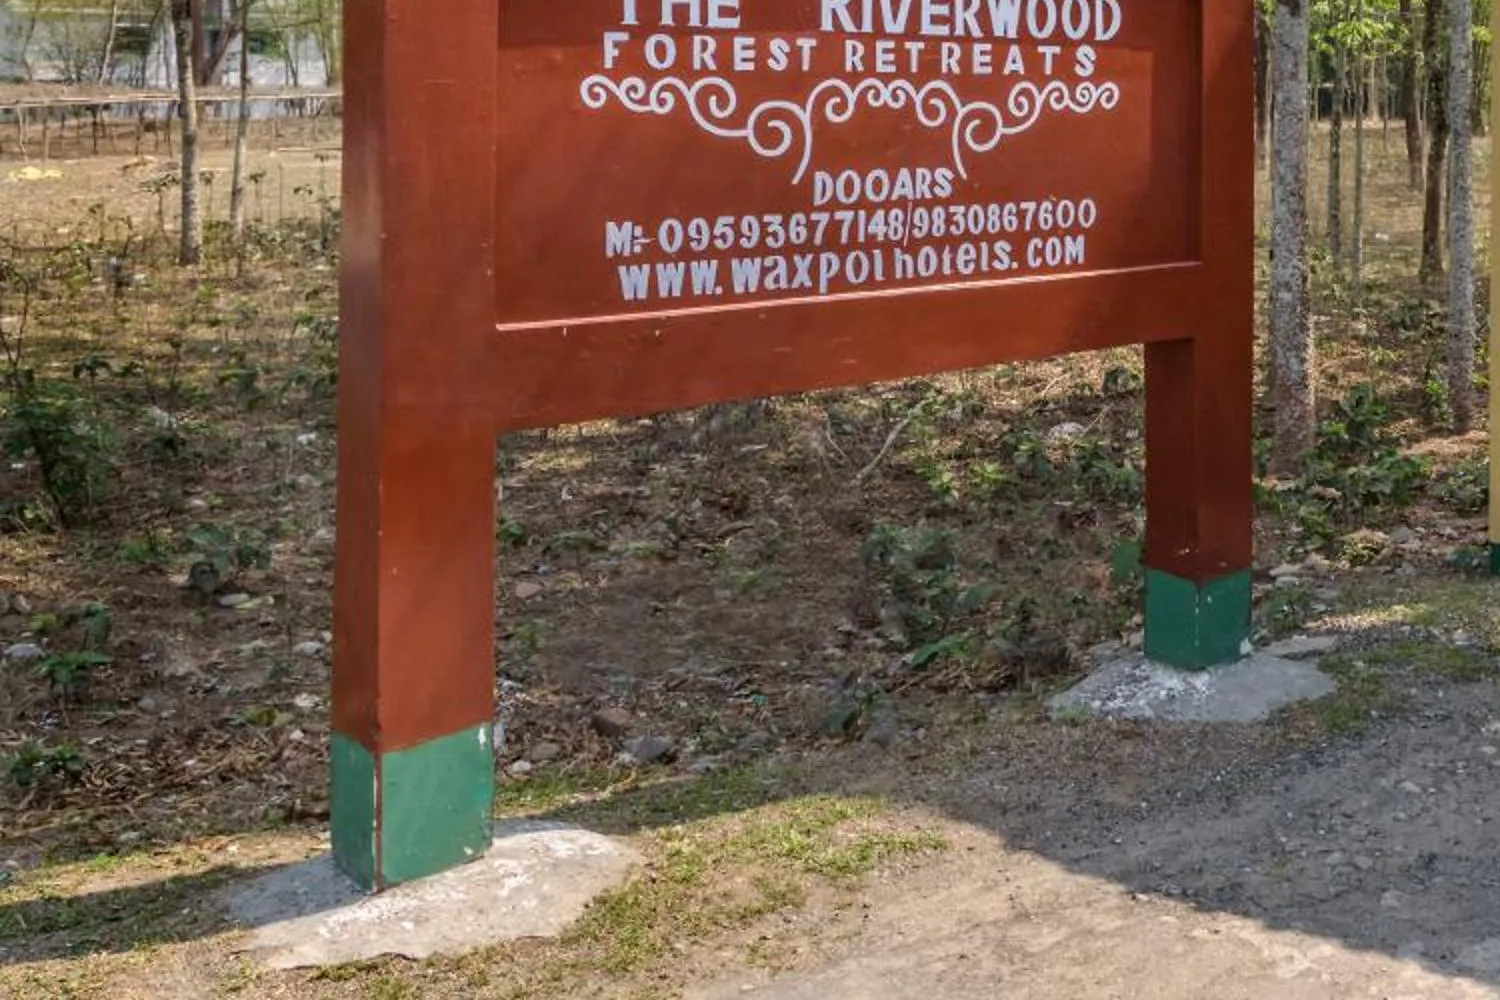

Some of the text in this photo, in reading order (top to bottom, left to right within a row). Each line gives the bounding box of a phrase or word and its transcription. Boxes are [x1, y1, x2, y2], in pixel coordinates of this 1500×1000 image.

[603, 31, 1097, 76] FOREST RETREATS
[813, 167, 953, 206] DOOARS
